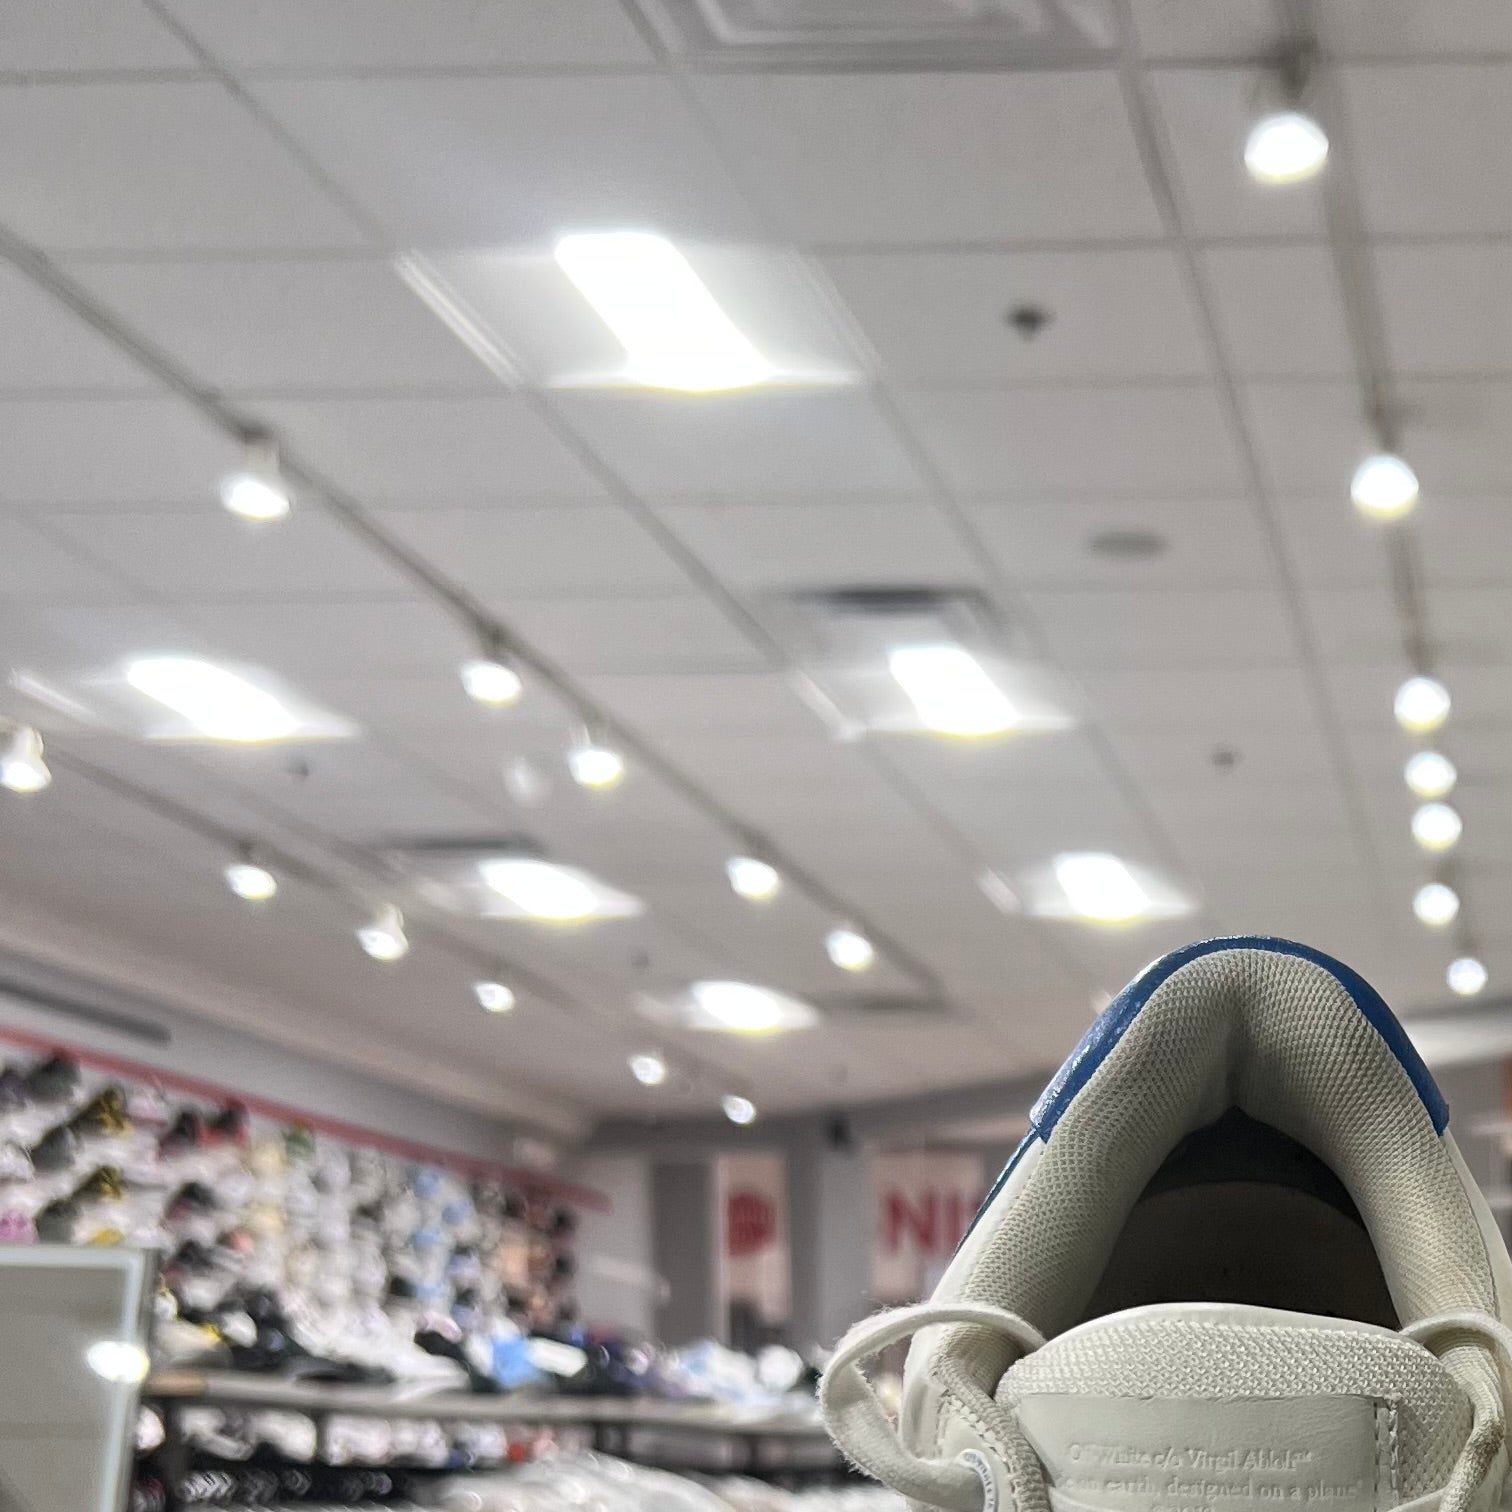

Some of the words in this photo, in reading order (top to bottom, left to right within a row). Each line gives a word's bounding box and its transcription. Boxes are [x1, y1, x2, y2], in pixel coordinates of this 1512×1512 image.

[1185, 1448, 1239, 1475] Virgil
[1167, 1475, 1253, 1502] designed
[1259, 1483, 1284, 1501] on
[1289, 1484, 1302, 1500] a
